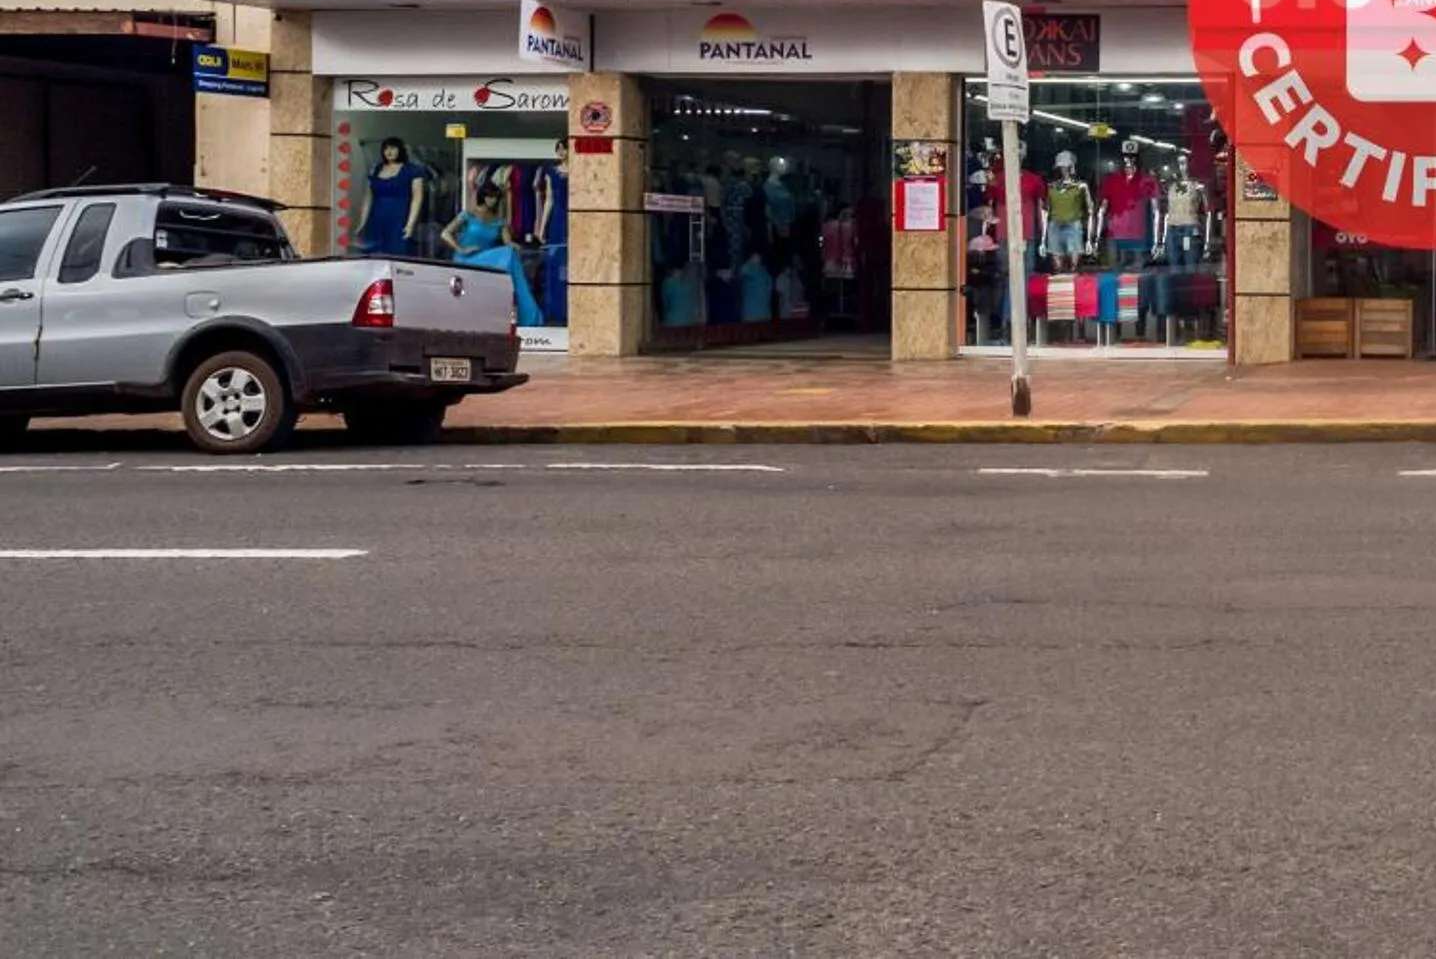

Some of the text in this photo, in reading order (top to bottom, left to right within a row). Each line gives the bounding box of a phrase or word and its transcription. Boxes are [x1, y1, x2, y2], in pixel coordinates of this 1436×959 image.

[527, 34, 583, 61] PANTANAL
[1004, 18, 1017, 57] E
[700, 42, 812, 59] PANTANAL
[1028, 43, 1082, 66] ANS
[432, 89, 456, 108] de
[1335, 232, 1368, 244] OYO
